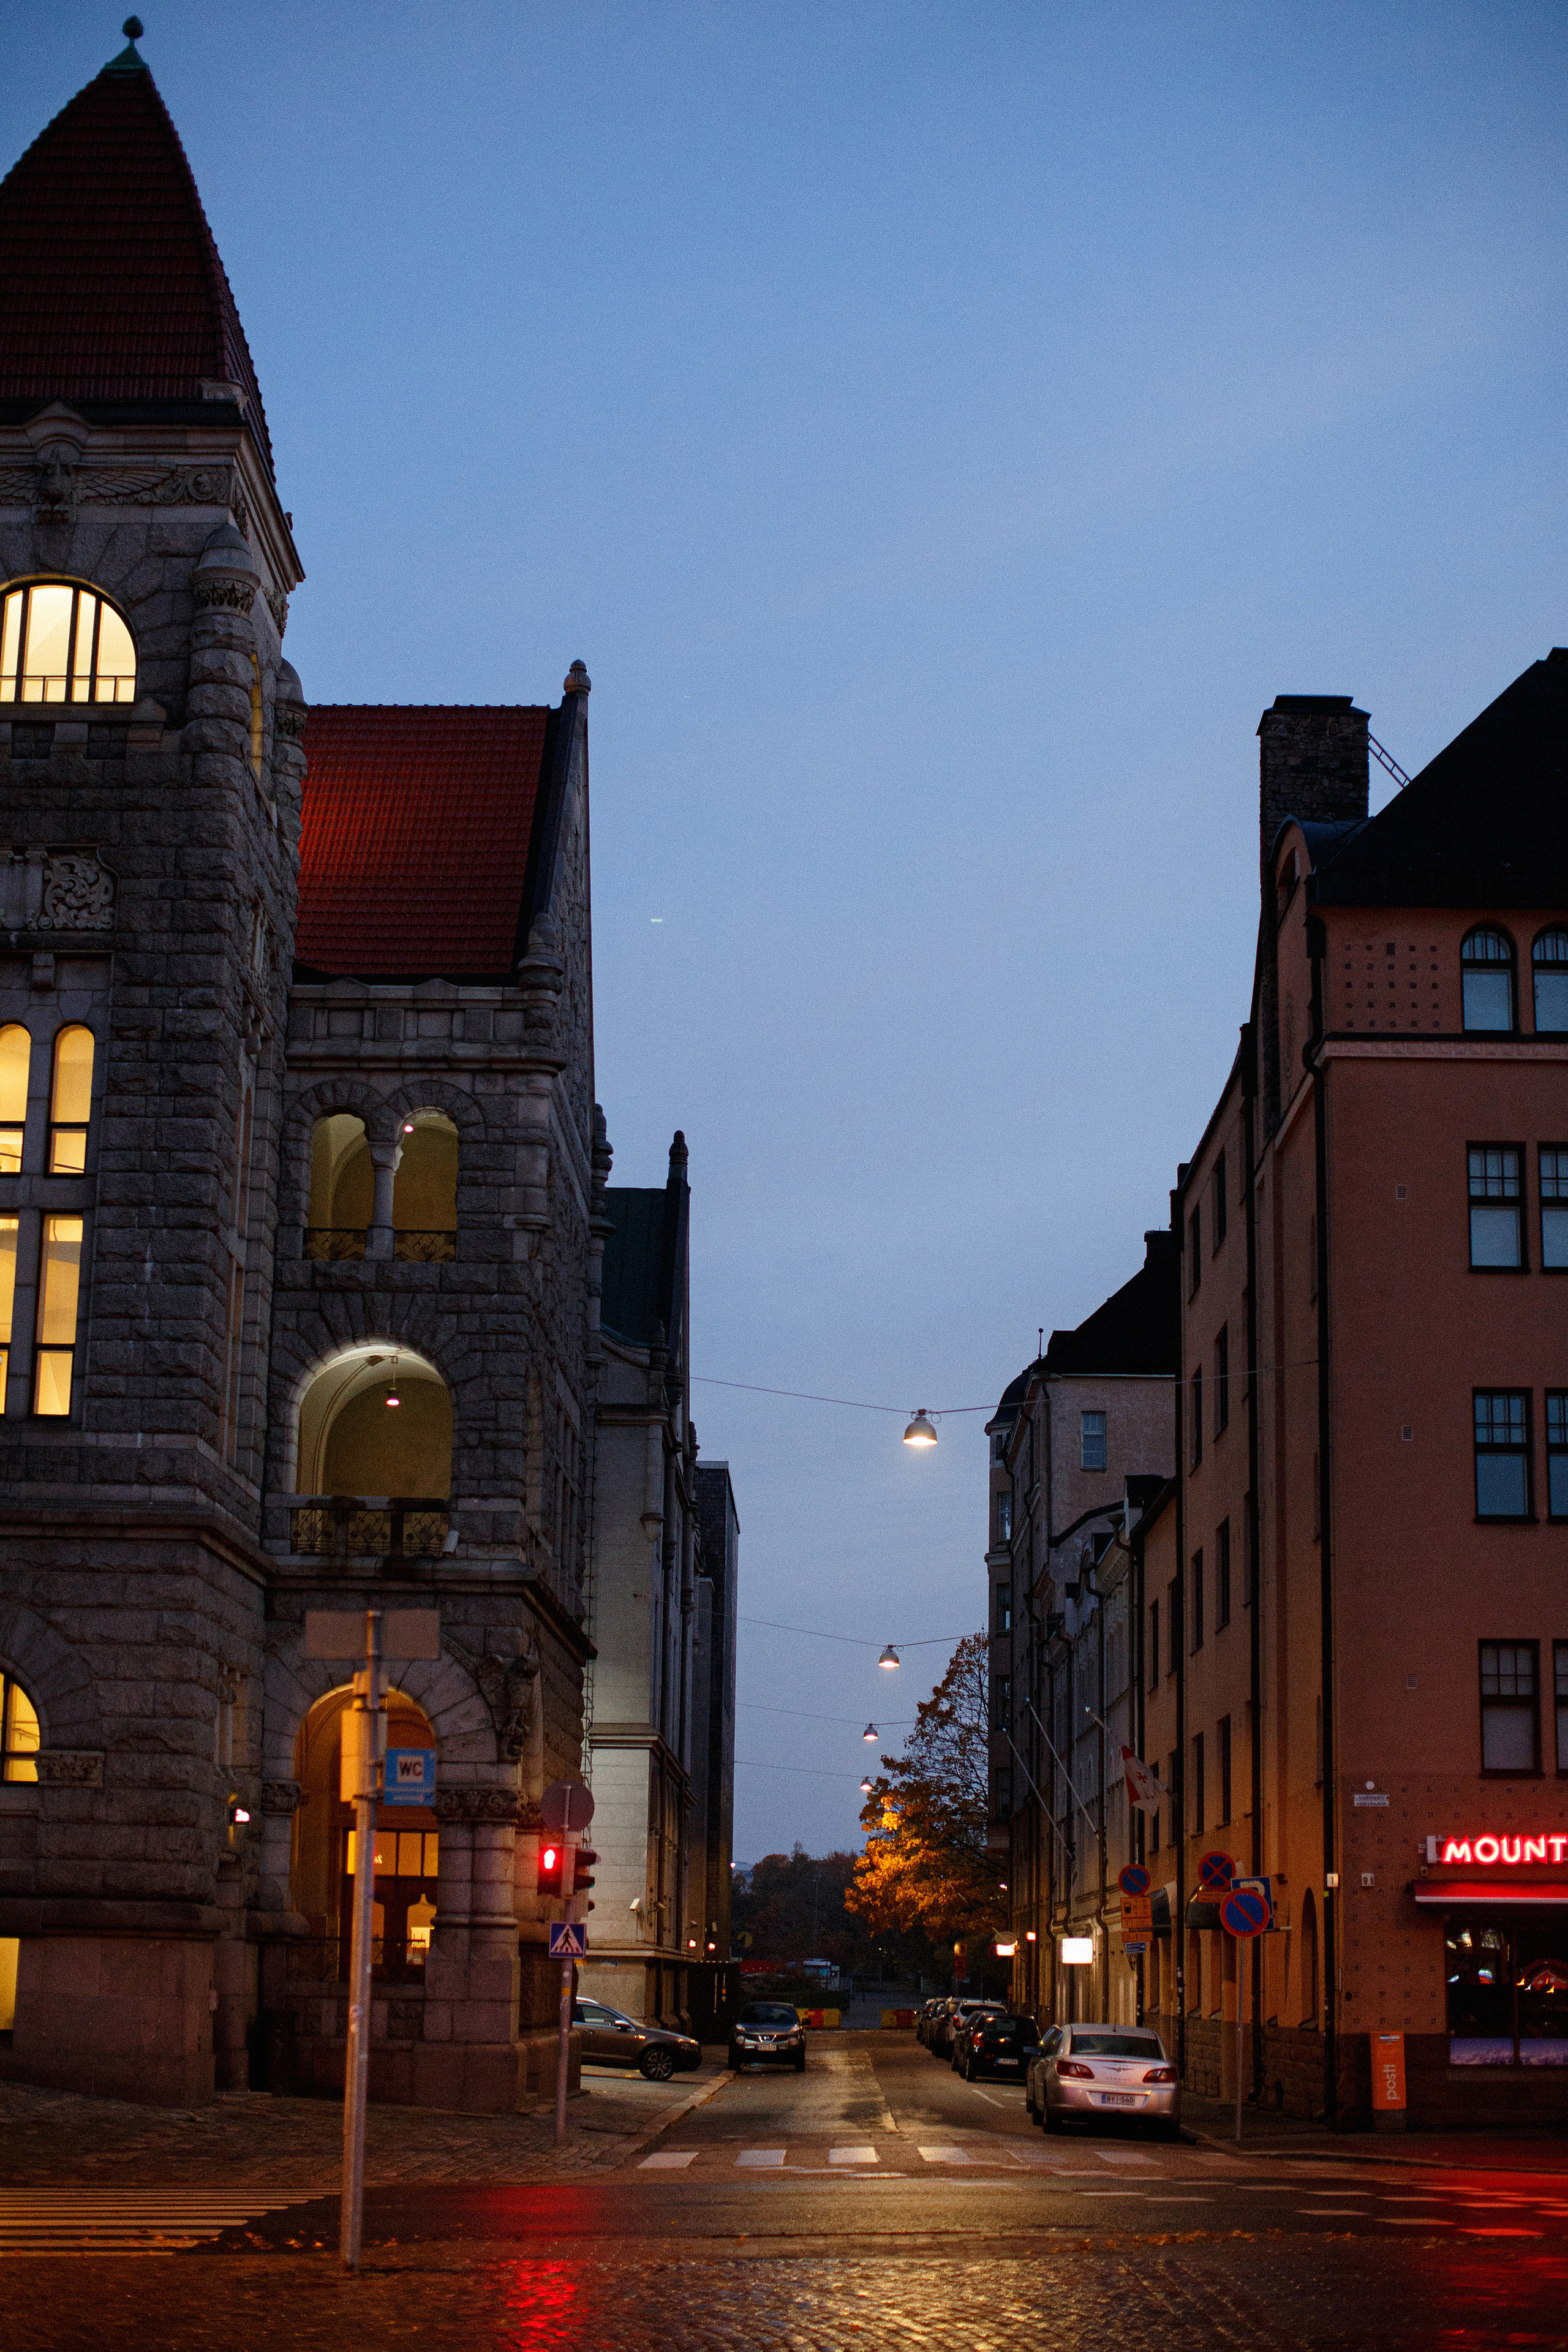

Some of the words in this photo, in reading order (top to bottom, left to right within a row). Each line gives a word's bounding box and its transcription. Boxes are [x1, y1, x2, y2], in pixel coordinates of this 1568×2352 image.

[399, 1760, 423, 1776] WC
[1443, 1834, 1568, 1864] MOUNT
[1382, 2064, 1400, 2100] posti
